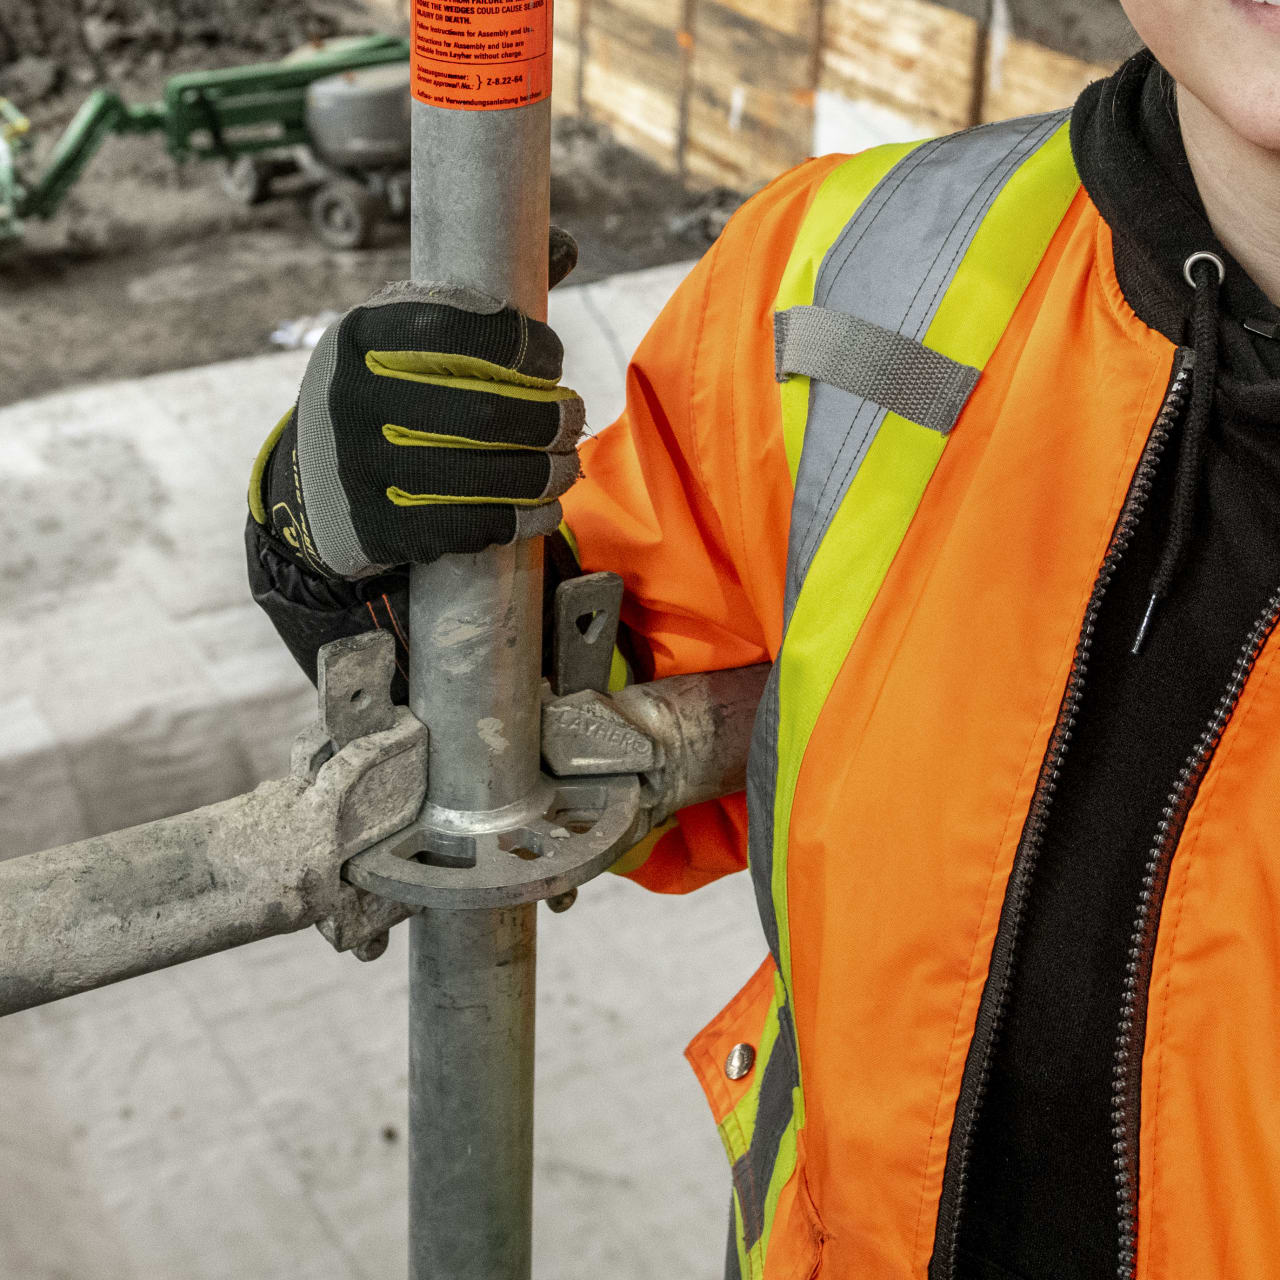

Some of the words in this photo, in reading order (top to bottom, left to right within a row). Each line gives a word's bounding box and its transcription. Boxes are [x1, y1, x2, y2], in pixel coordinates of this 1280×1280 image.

[431, 2, 442, 11] THE
[444, 5, 475, 14] WEDGES
[477, 6, 500, 15] COULD
[502, 4, 523, 13] CAUSE
[524, 0, 544, 10] SEIOUS
[435, 13, 444, 21] OR
[445, 16, 472, 25] DEATH.
[478, 30, 509, 38] Assembly
[511, 27, 522, 36] and
[444, 40, 452, 48] for
[454, 41, 486, 51] Assembly
[488, 42, 500, 50] and
[502, 41, 514, 49] Use
[435, 48, 448, 57] from
[449, 51, 472, 60] Layher
[474, 52, 500, 60] without
[486, 74, 523, 87] Z-8.22-64
[434, 95, 444, 103] und
